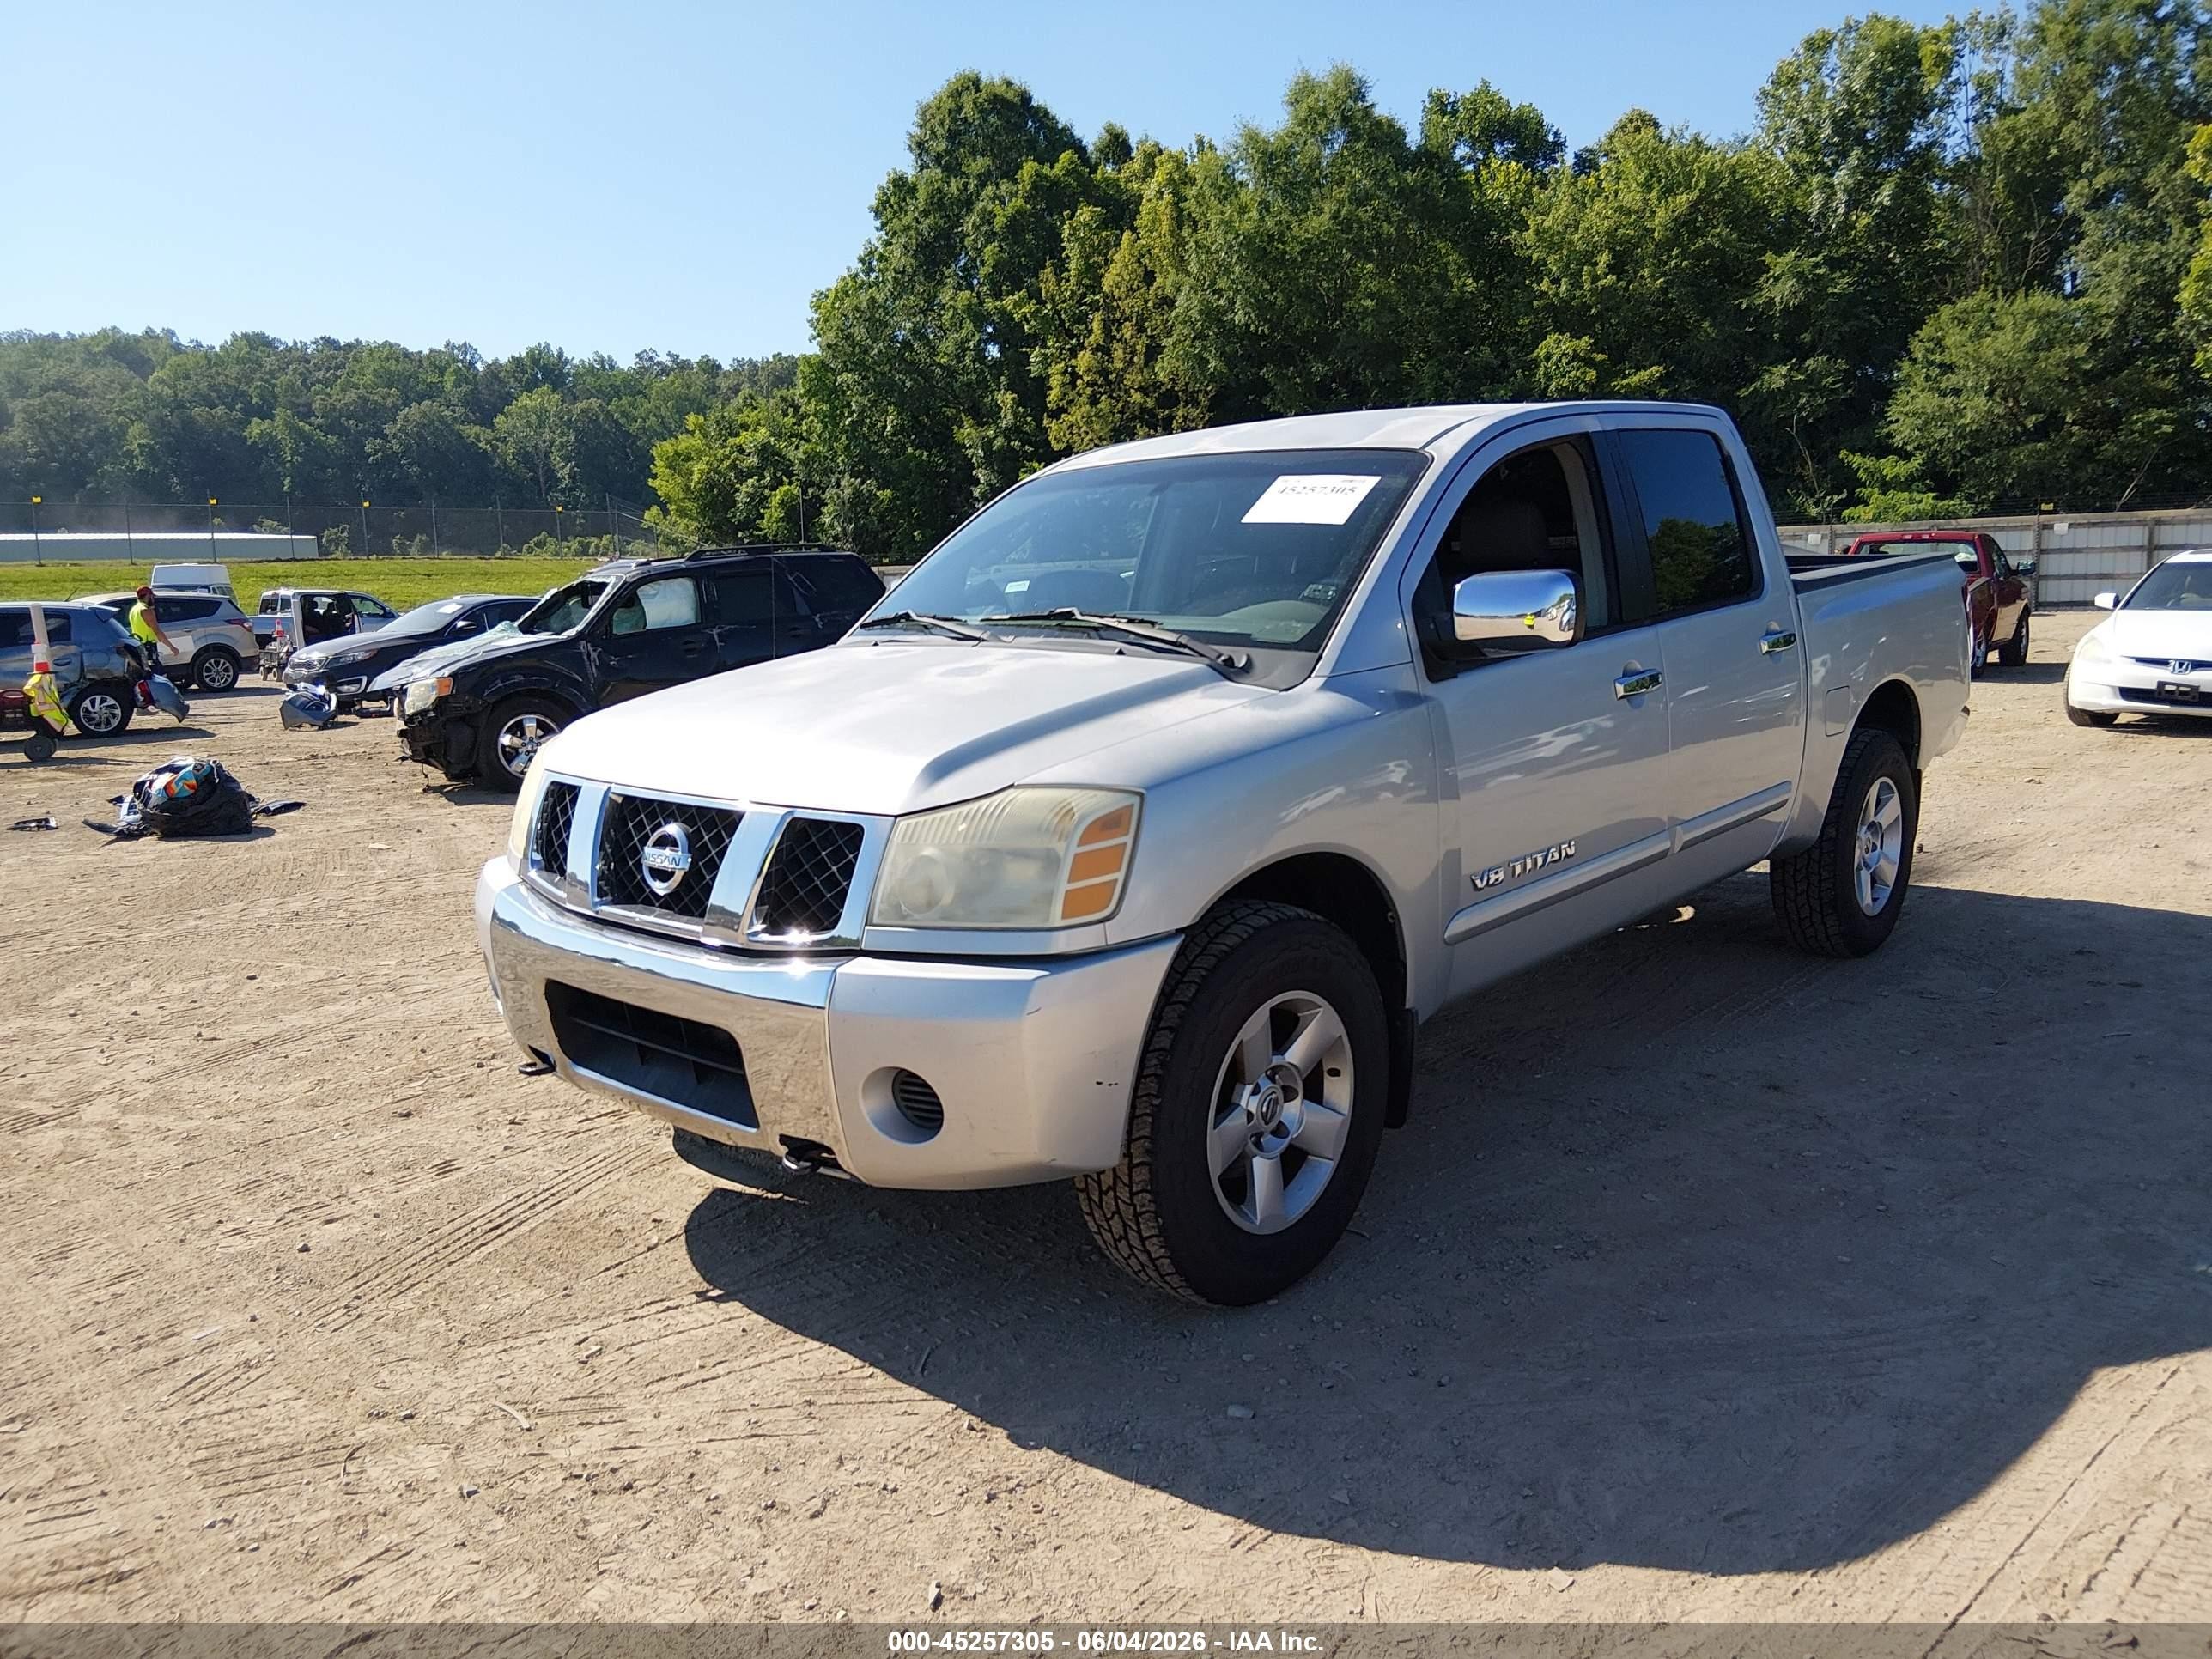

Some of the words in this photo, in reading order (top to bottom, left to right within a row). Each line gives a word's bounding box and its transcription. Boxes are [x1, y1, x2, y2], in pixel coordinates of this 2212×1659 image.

[642, 852, 681, 866] NISSAN
[1470, 866, 1504, 890] V8
[1508, 840, 1577, 878] TITAN
